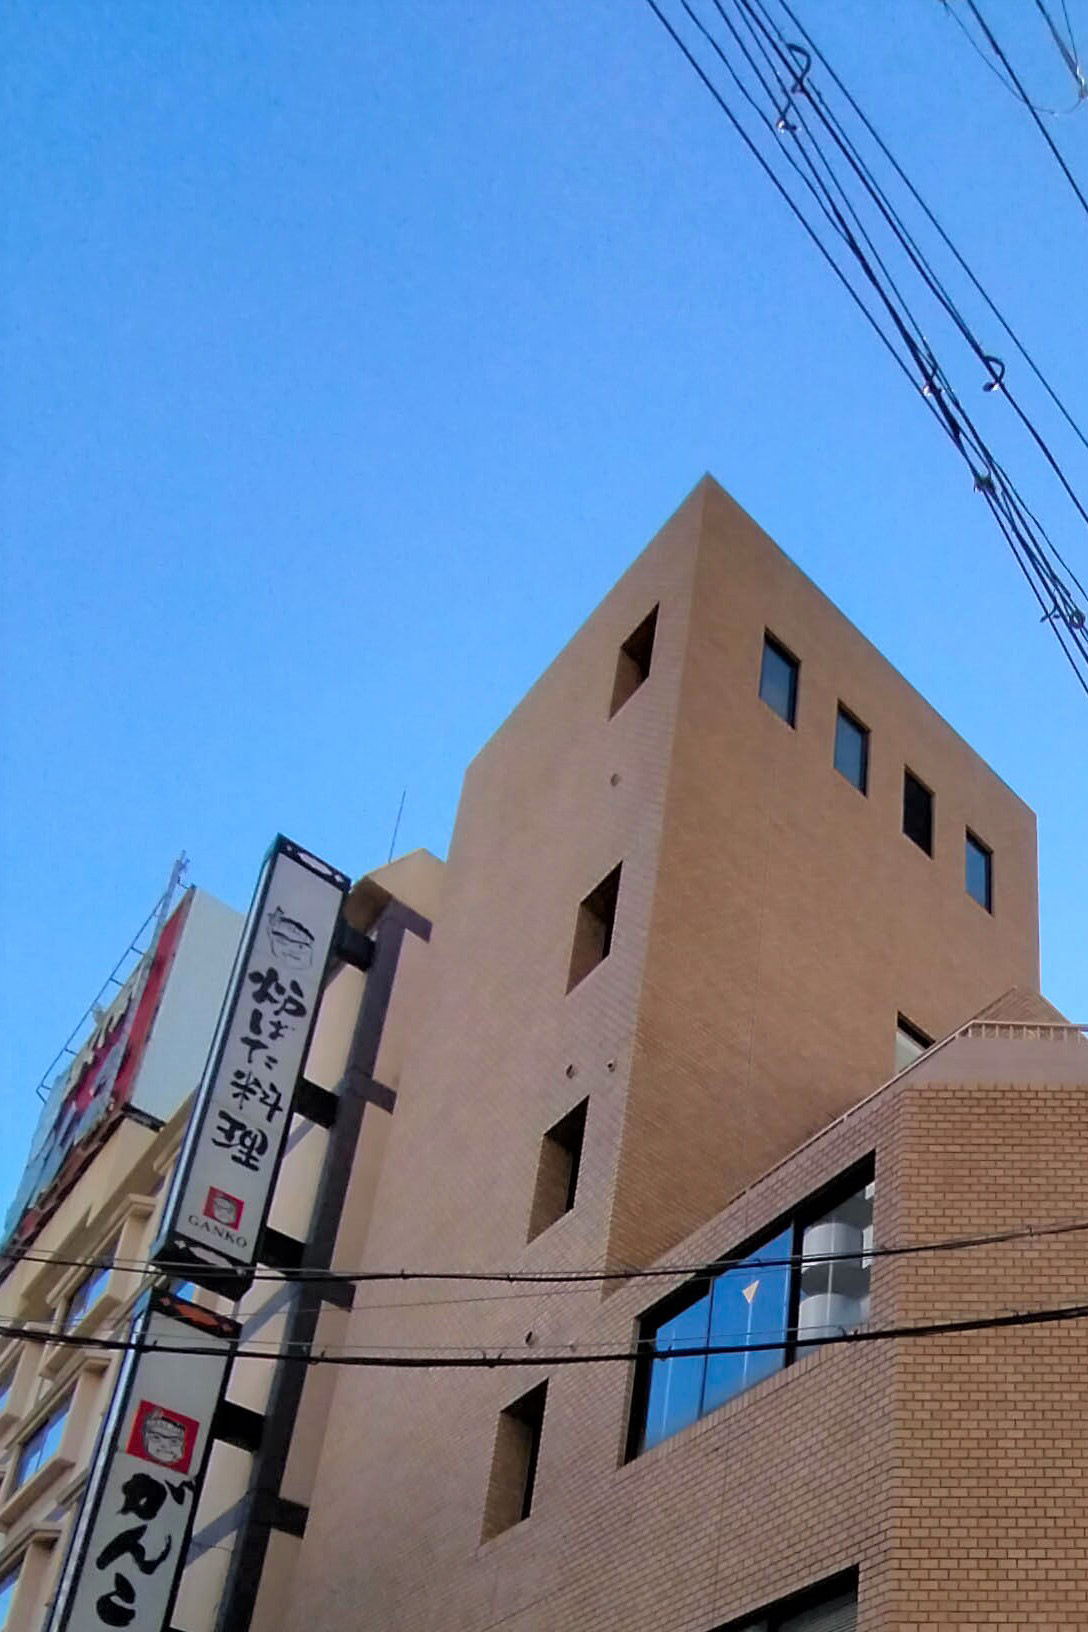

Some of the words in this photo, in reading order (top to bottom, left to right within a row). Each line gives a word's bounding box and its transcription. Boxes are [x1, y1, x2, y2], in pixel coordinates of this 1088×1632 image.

[211, 967, 307, 1172] 炉ばた料理
[188, 1215, 247, 1248] GANKO
